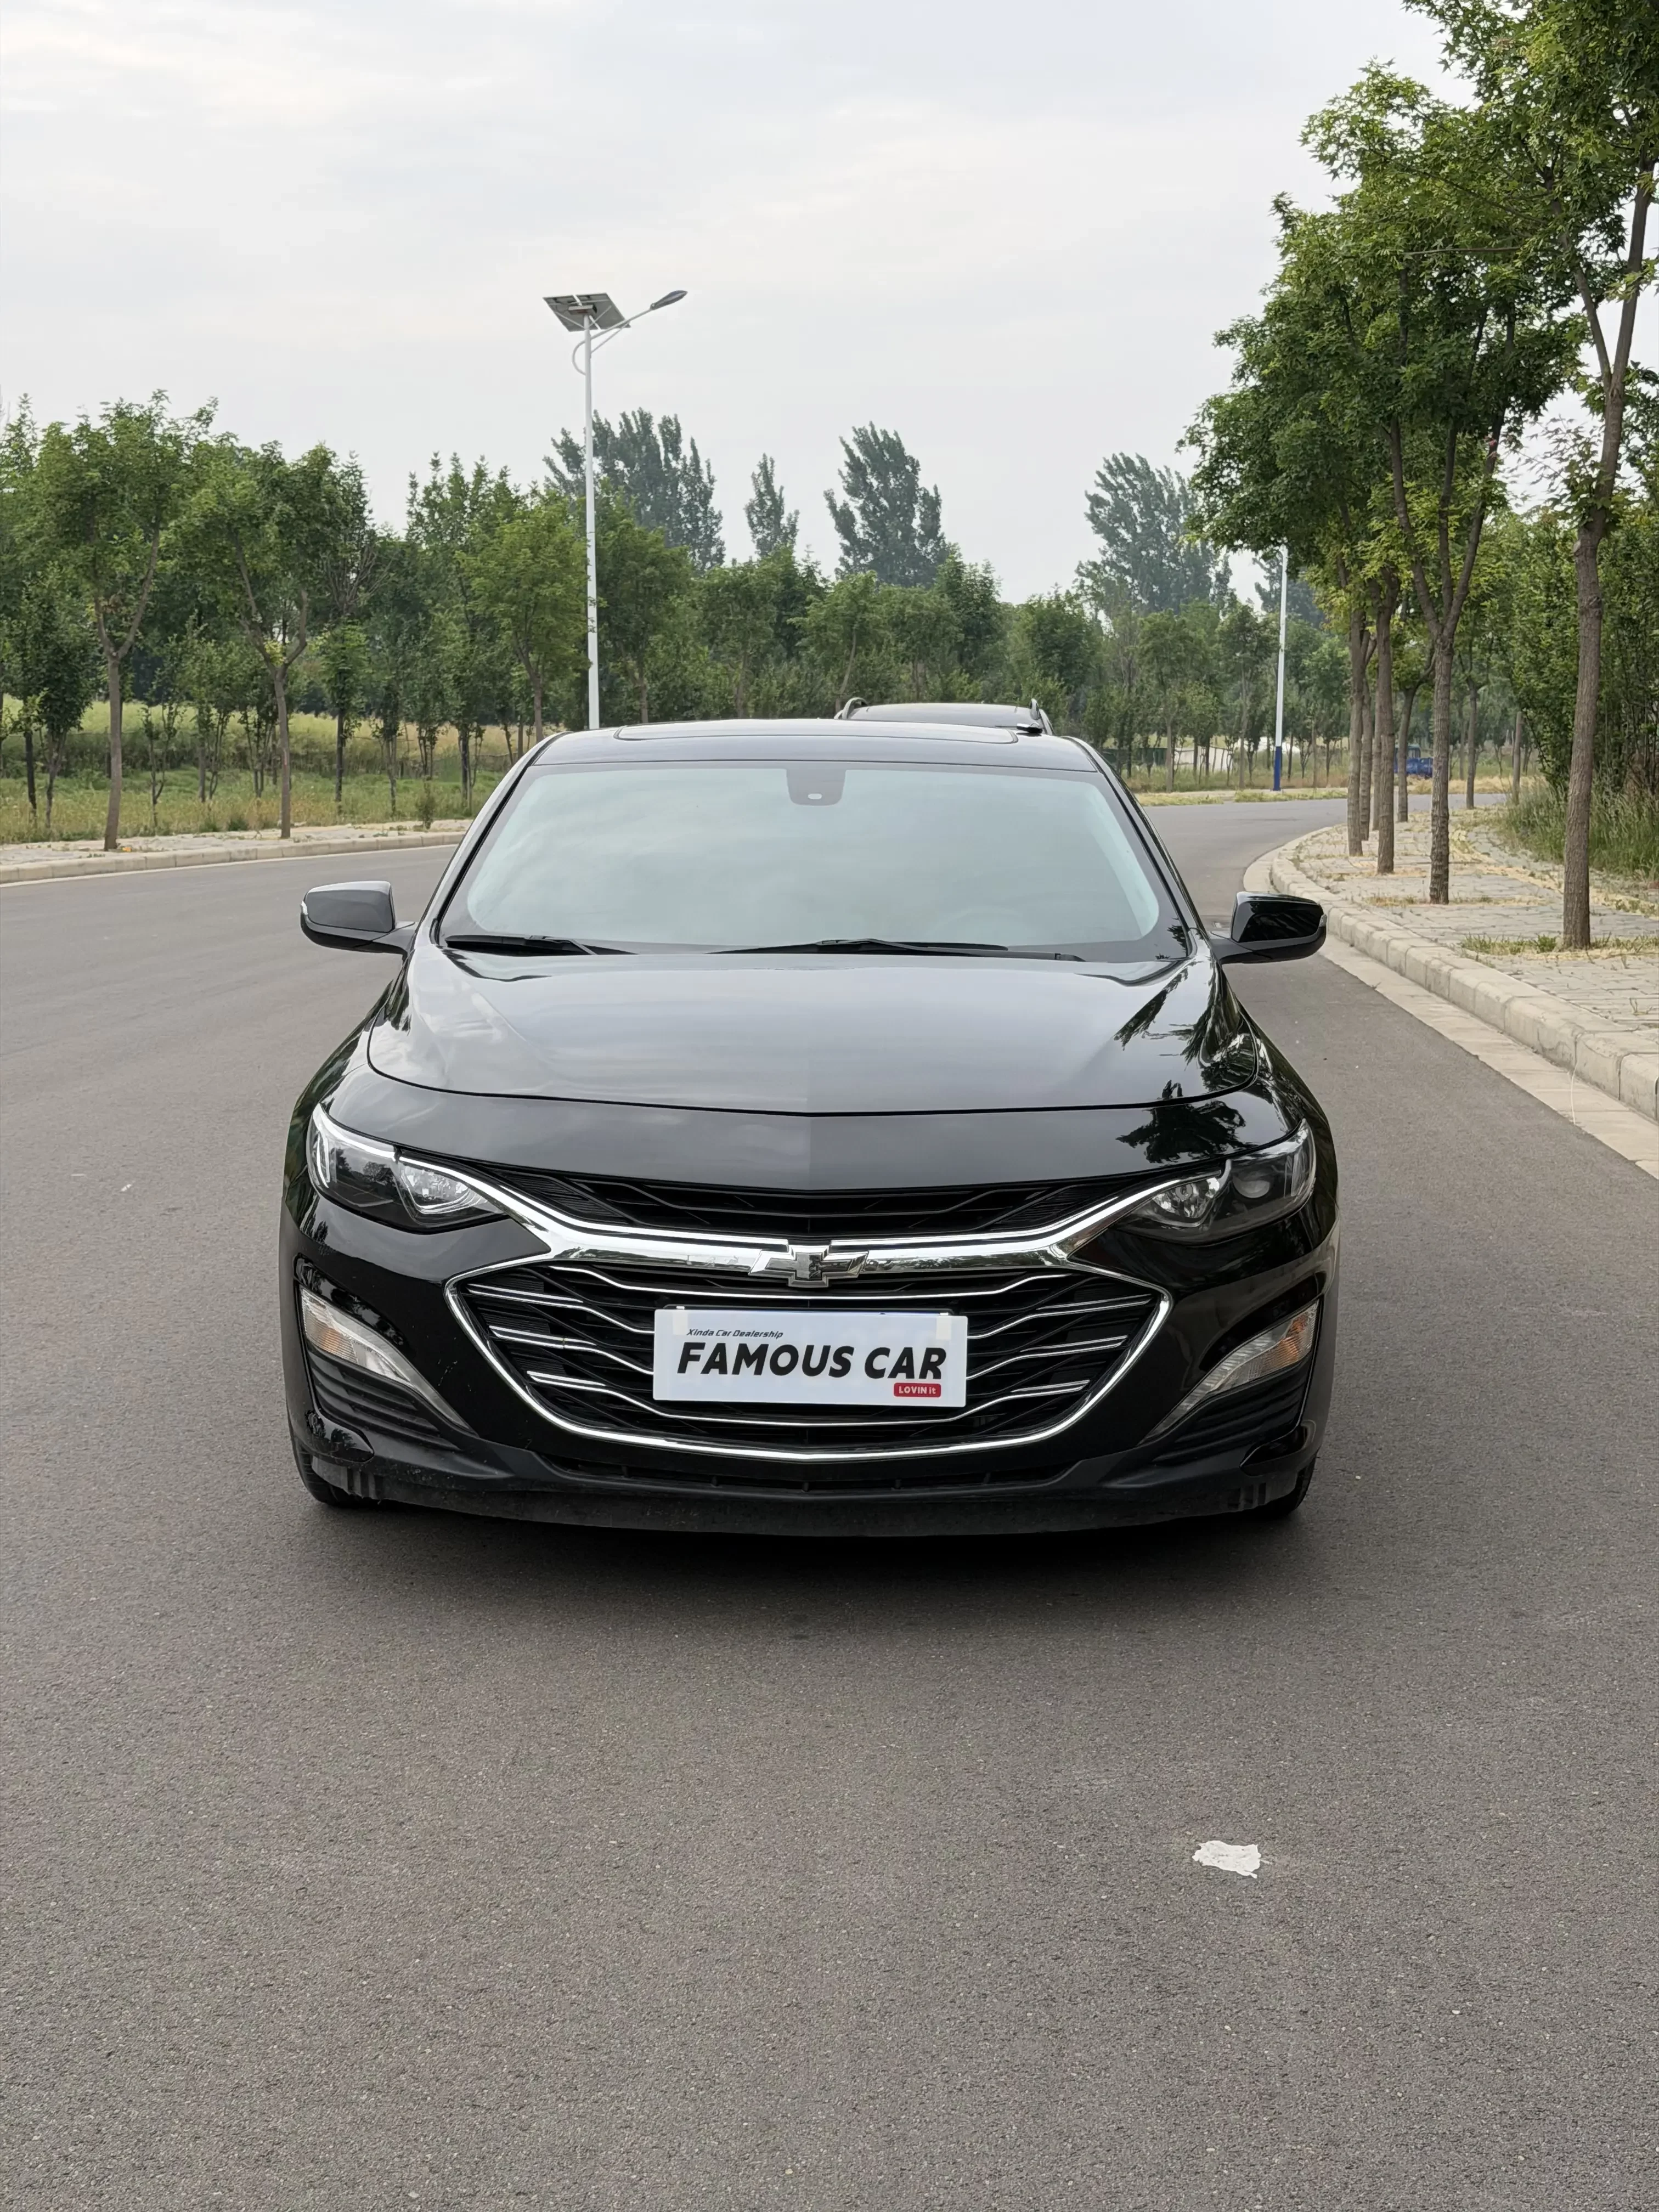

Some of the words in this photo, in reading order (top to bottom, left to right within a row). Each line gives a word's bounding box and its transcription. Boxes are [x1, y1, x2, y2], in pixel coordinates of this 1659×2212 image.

[686, 1328, 714, 1336] Xinda
[732, 1330, 784, 1340] Dealership
[677, 1342, 855, 1378] FAMOUS
[864, 1347, 946, 1380] CAR
[899, 1386, 927, 1394] LOVIN
[929, 1386, 936, 1395] it
